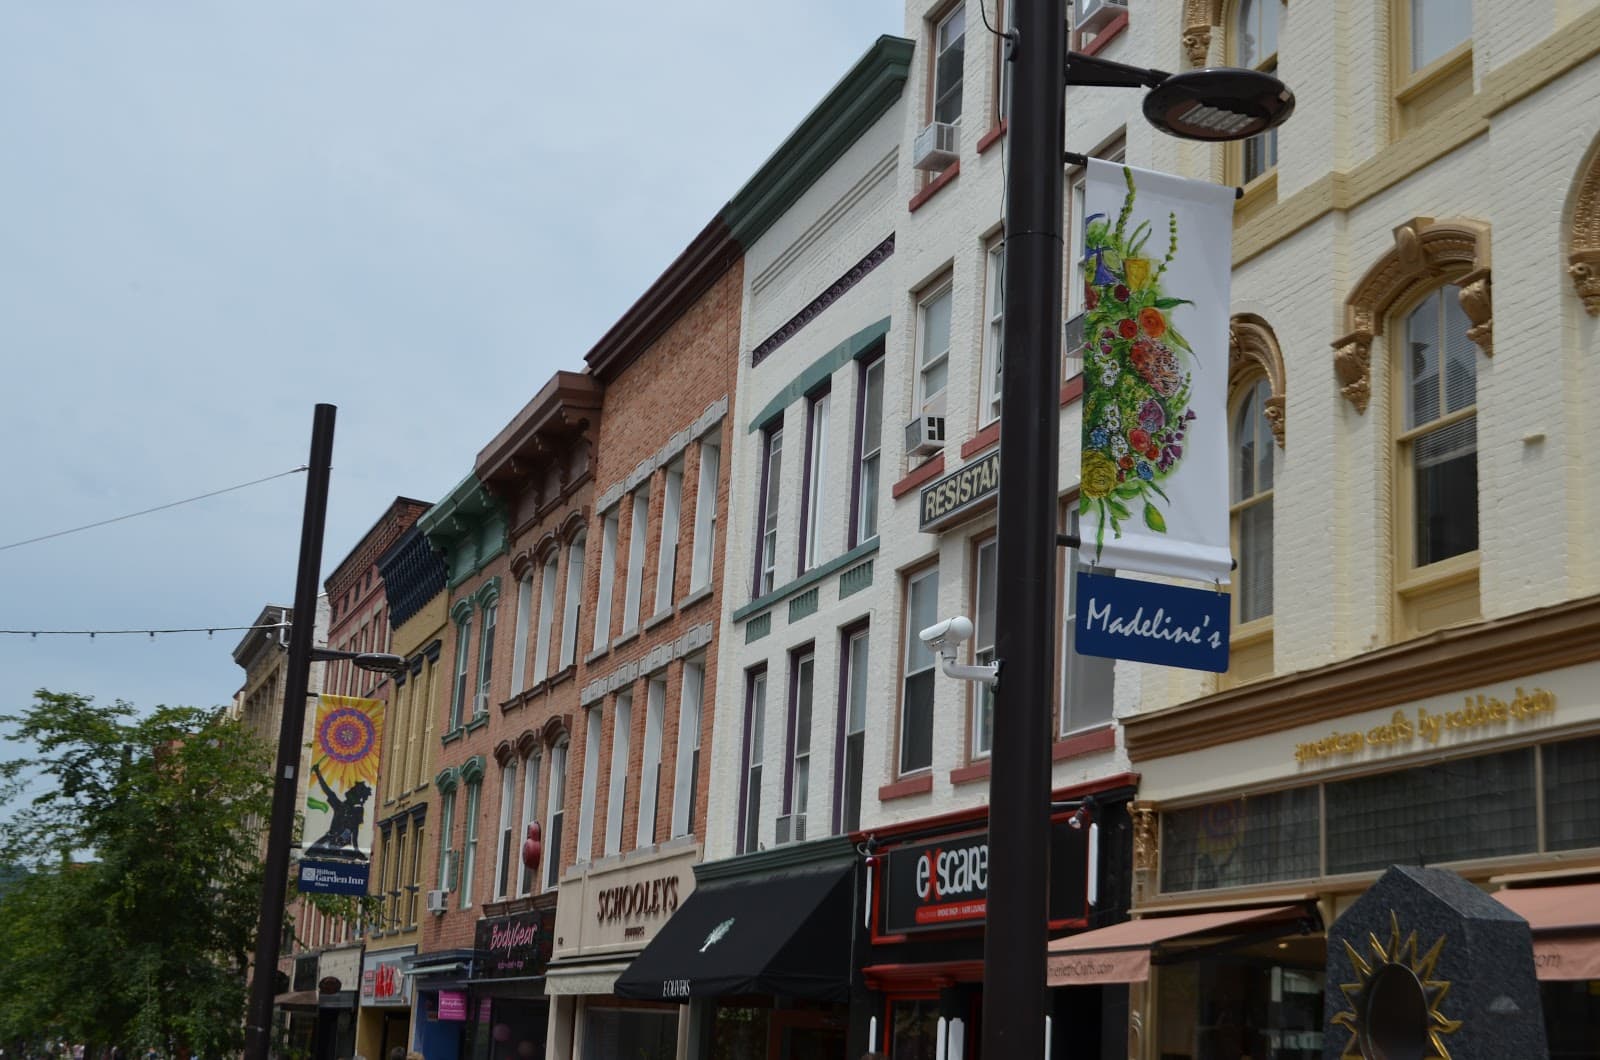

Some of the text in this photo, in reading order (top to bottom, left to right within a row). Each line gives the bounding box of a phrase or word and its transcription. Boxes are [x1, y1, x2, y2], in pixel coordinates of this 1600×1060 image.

[1086, 597, 1222, 649] Madeline's
[1417, 707, 1443, 744] by
[315, 874, 364, 885] Garden Inn
[597, 876, 679, 920] SCHOOLEYS
[489, 921, 538, 959] BodyGear
